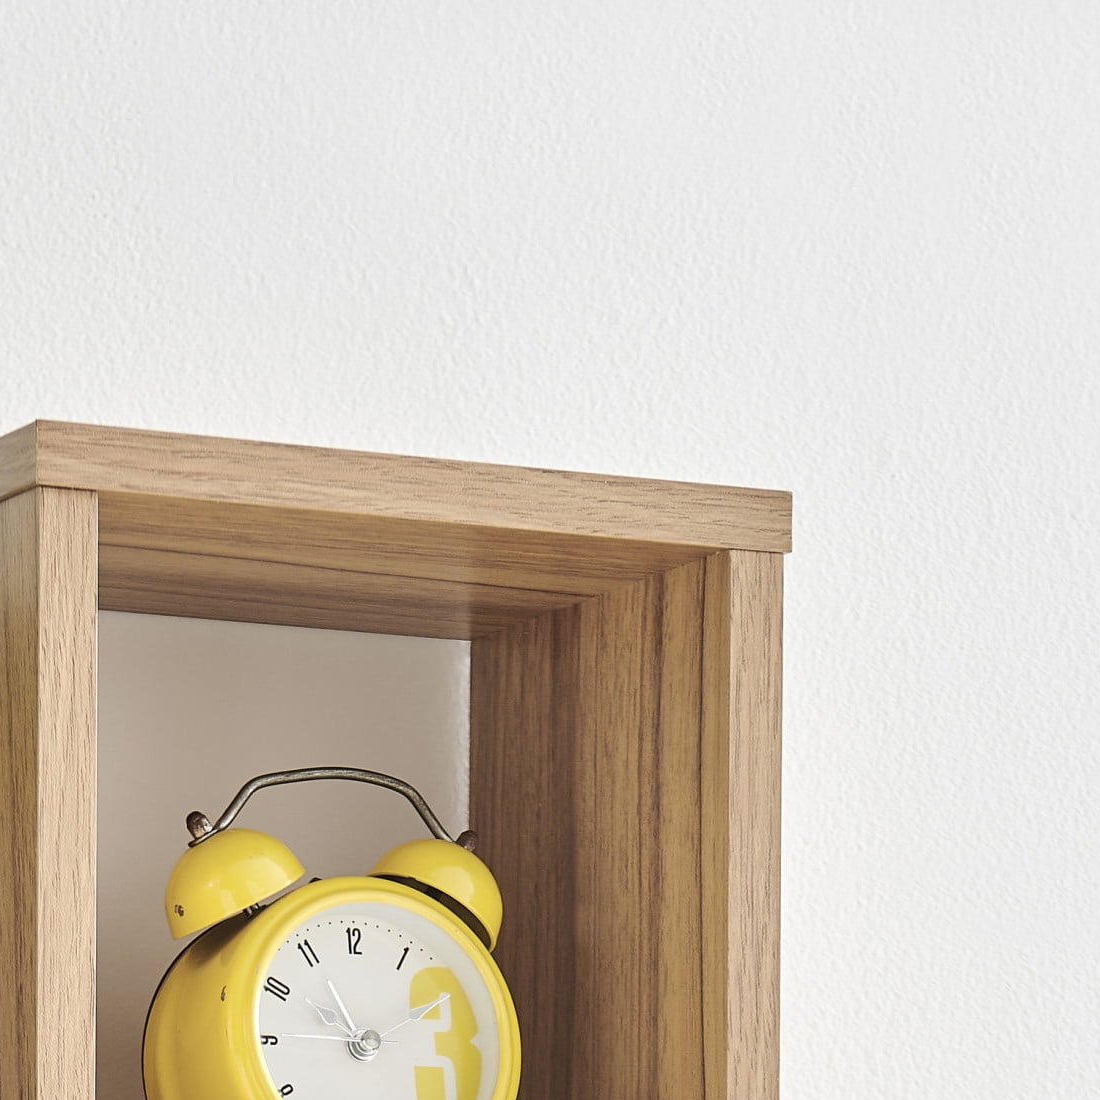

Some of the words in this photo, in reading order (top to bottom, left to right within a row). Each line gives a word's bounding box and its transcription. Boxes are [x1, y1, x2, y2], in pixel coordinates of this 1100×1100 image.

[297, 939, 320, 967] 11
[346, 927, 363, 955] 12
[396, 946, 410, 970] 1
[263, 976, 291, 1002] 10
[260, 1034, 278, 1046] 9
